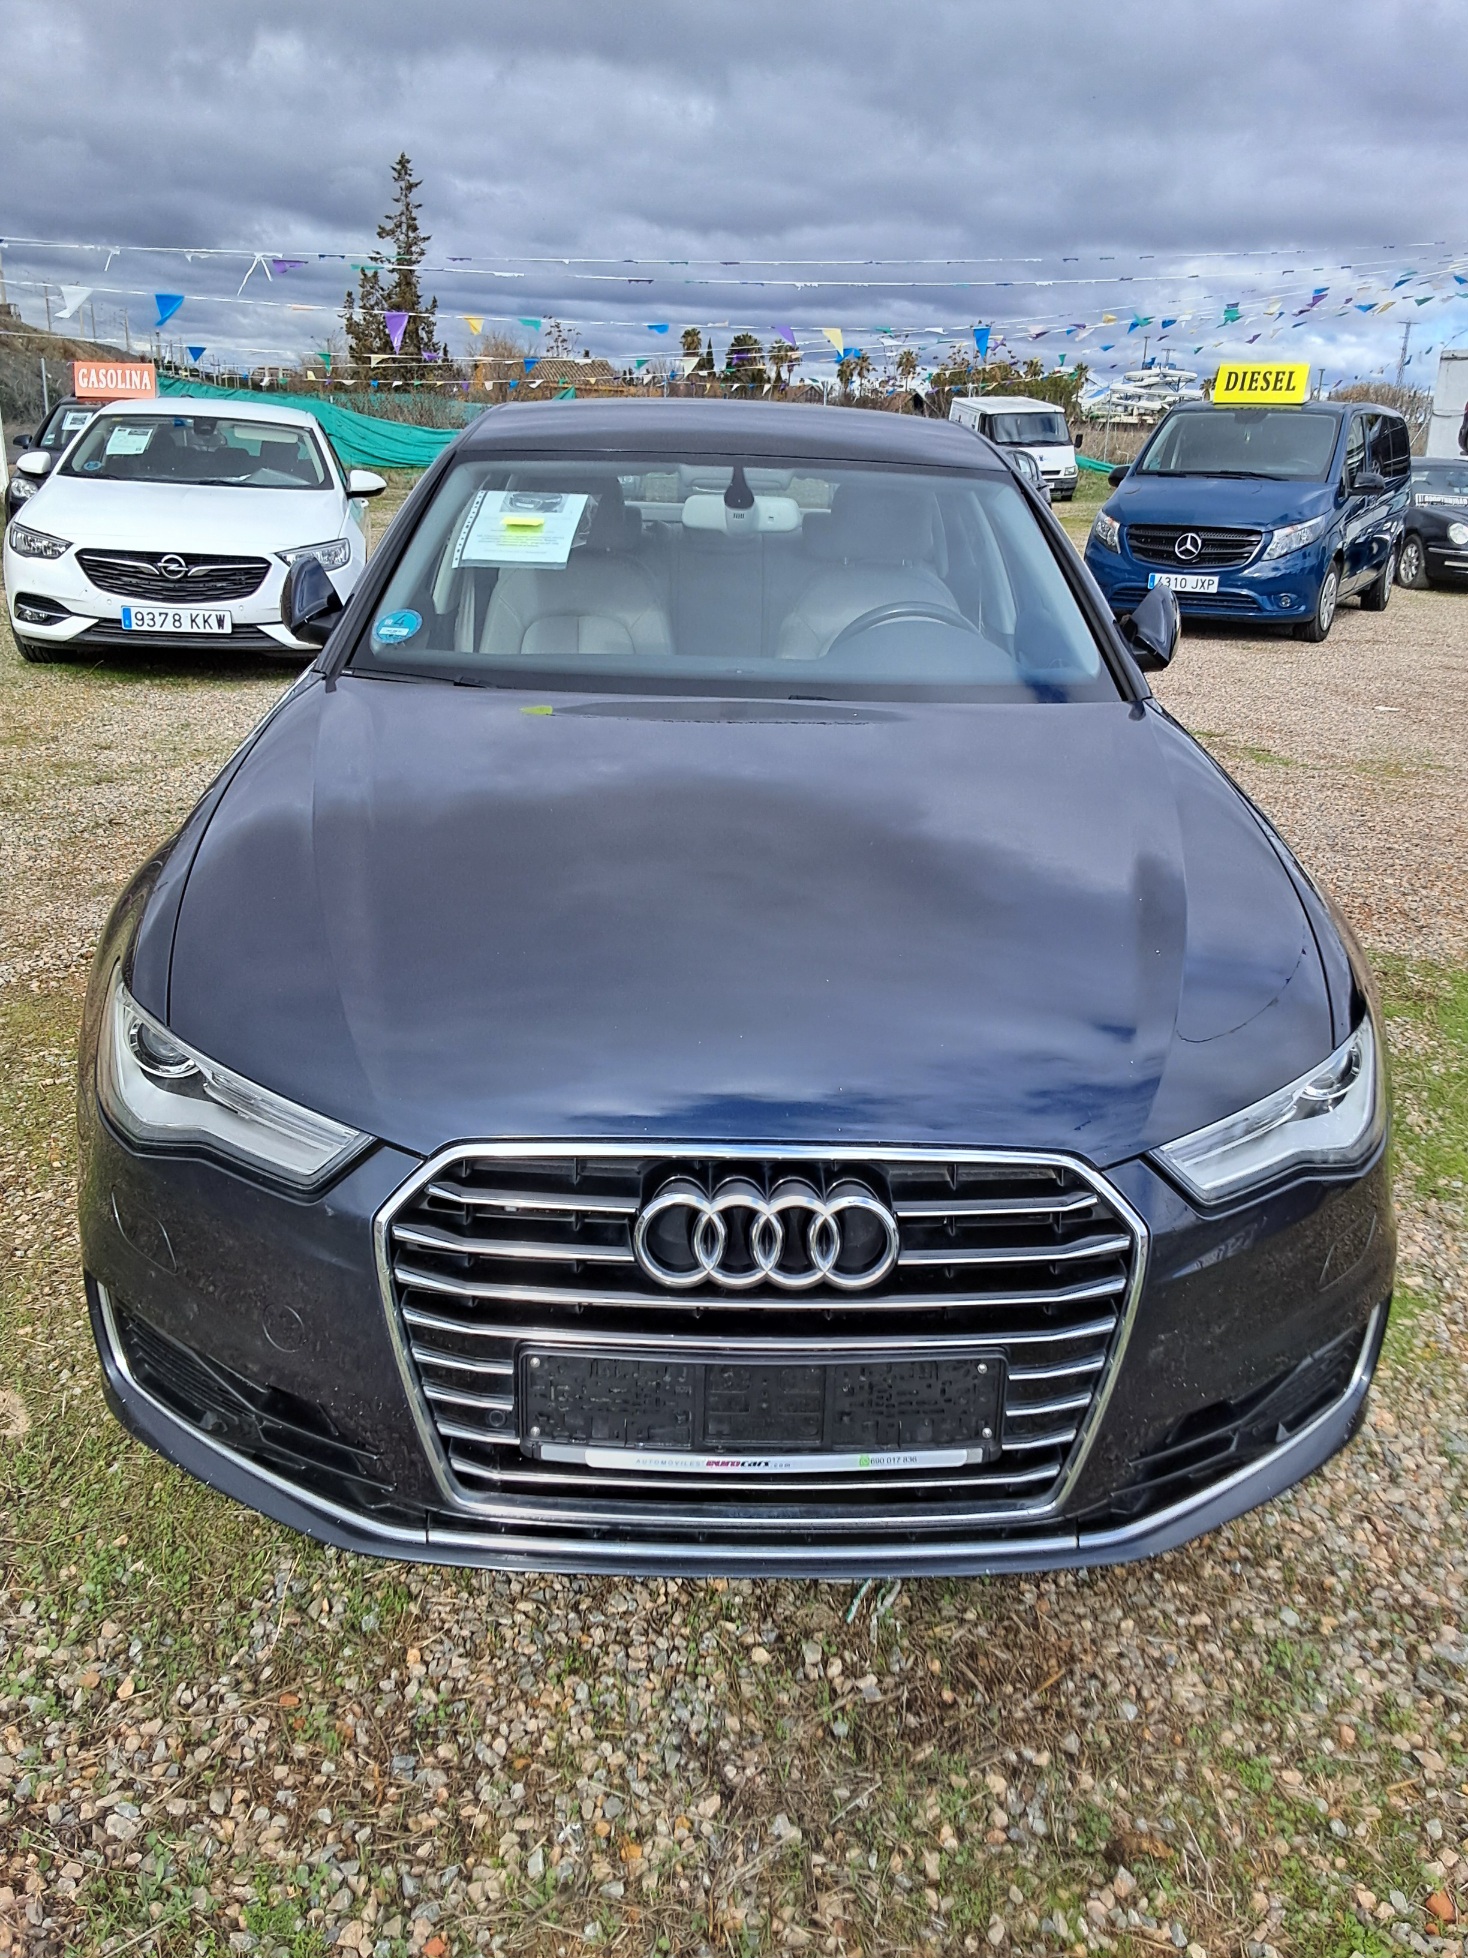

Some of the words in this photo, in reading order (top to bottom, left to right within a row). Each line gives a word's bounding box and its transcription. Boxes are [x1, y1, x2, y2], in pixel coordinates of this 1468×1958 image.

[77, 368, 152, 390] GASOLINA
[1223, 370, 1296, 392] DIESEL
[1191, 578, 1215, 591] JXP
[134, 611, 183, 629] 9378
[189, 612, 226, 630] KKW
